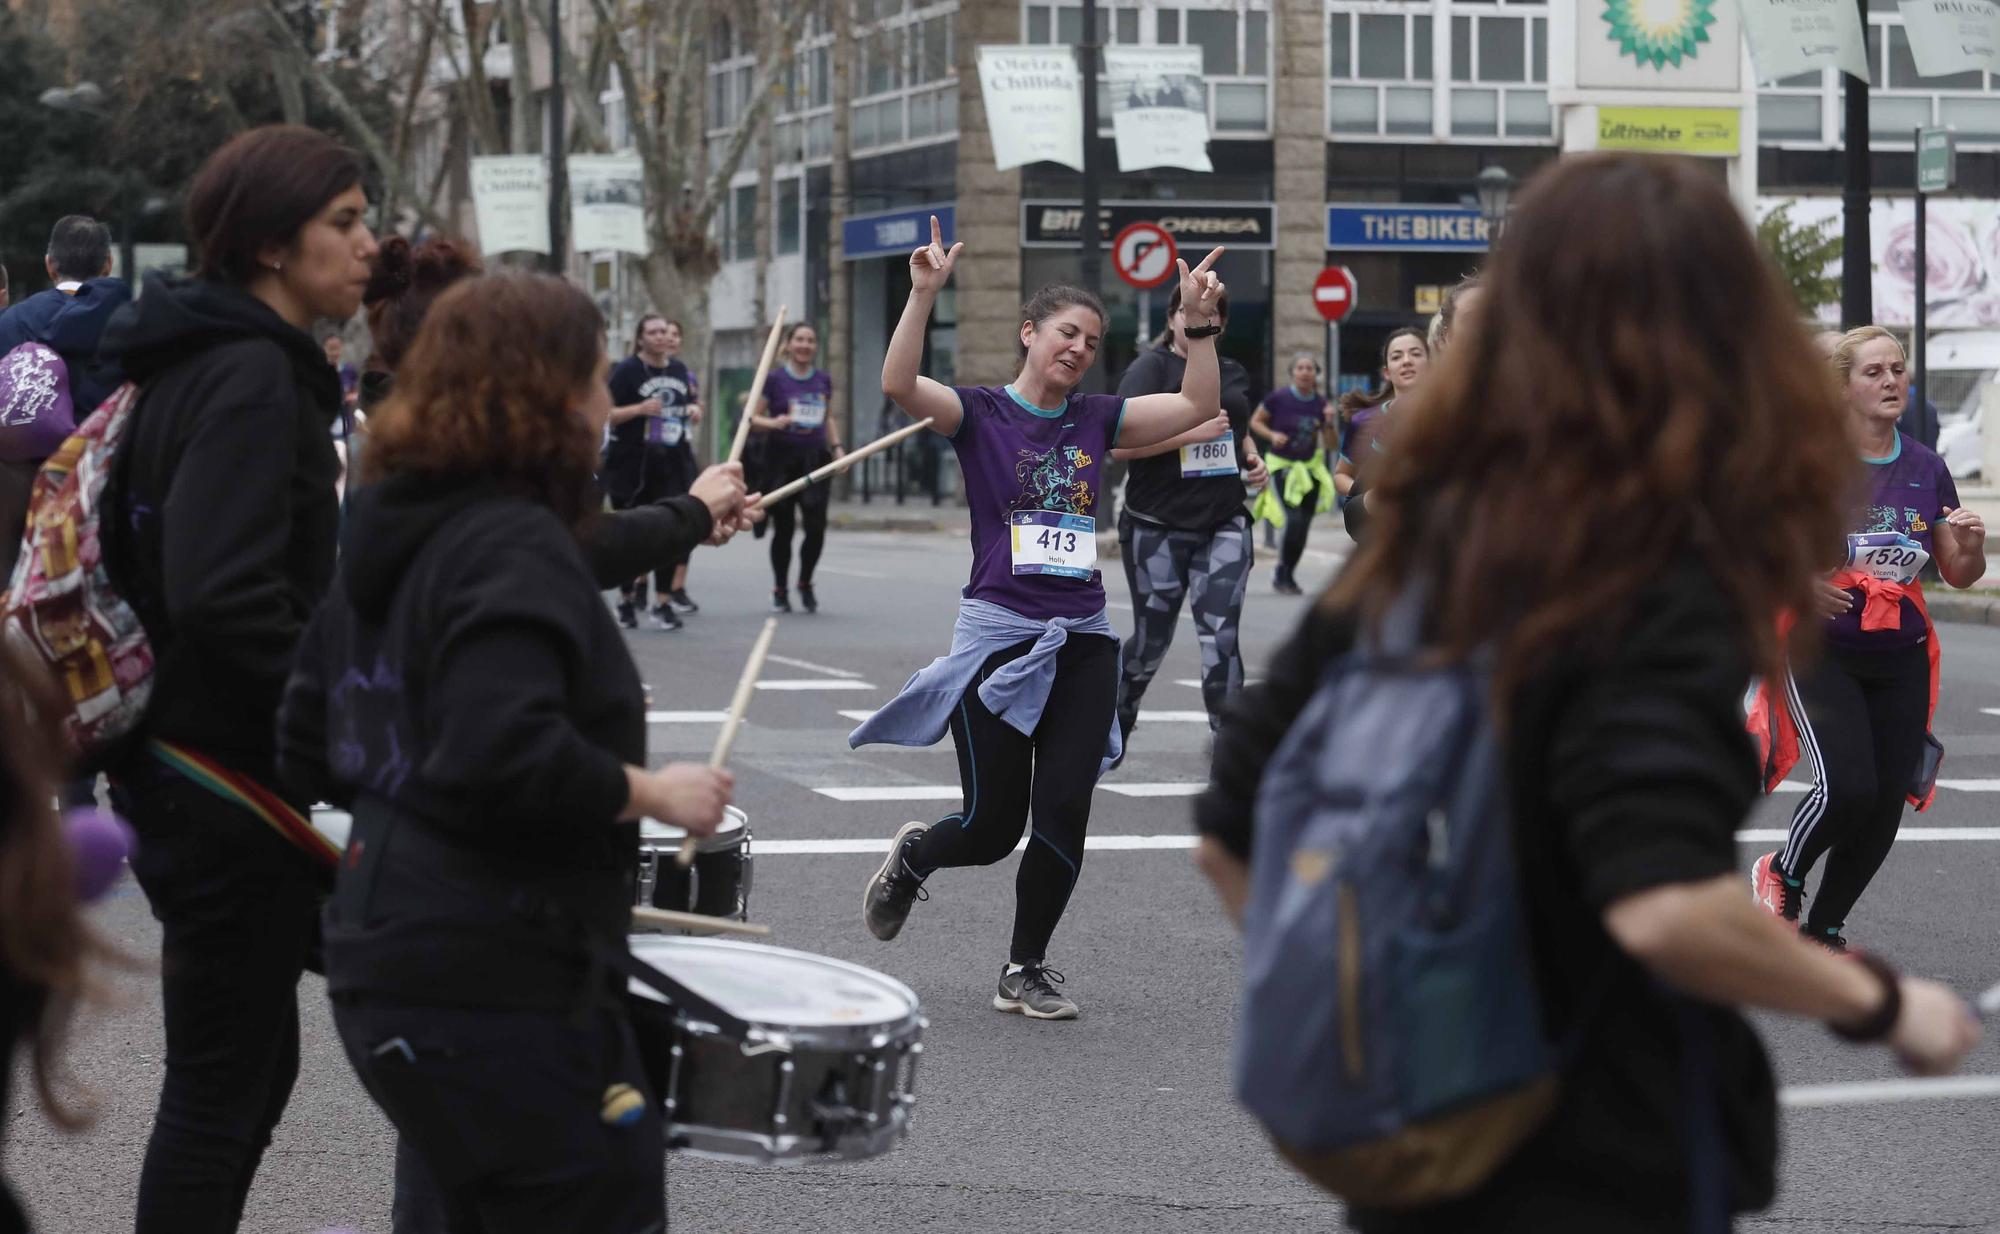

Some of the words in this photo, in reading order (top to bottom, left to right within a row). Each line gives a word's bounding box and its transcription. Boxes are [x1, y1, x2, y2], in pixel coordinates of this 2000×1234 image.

[1158, 216, 1260, 234] ORBEA
[1193, 443, 1227, 460] 1860
[1037, 528, 1077, 553] 413
[1048, 555, 1066, 564] Holly
[1865, 547, 1917, 567] 1520
